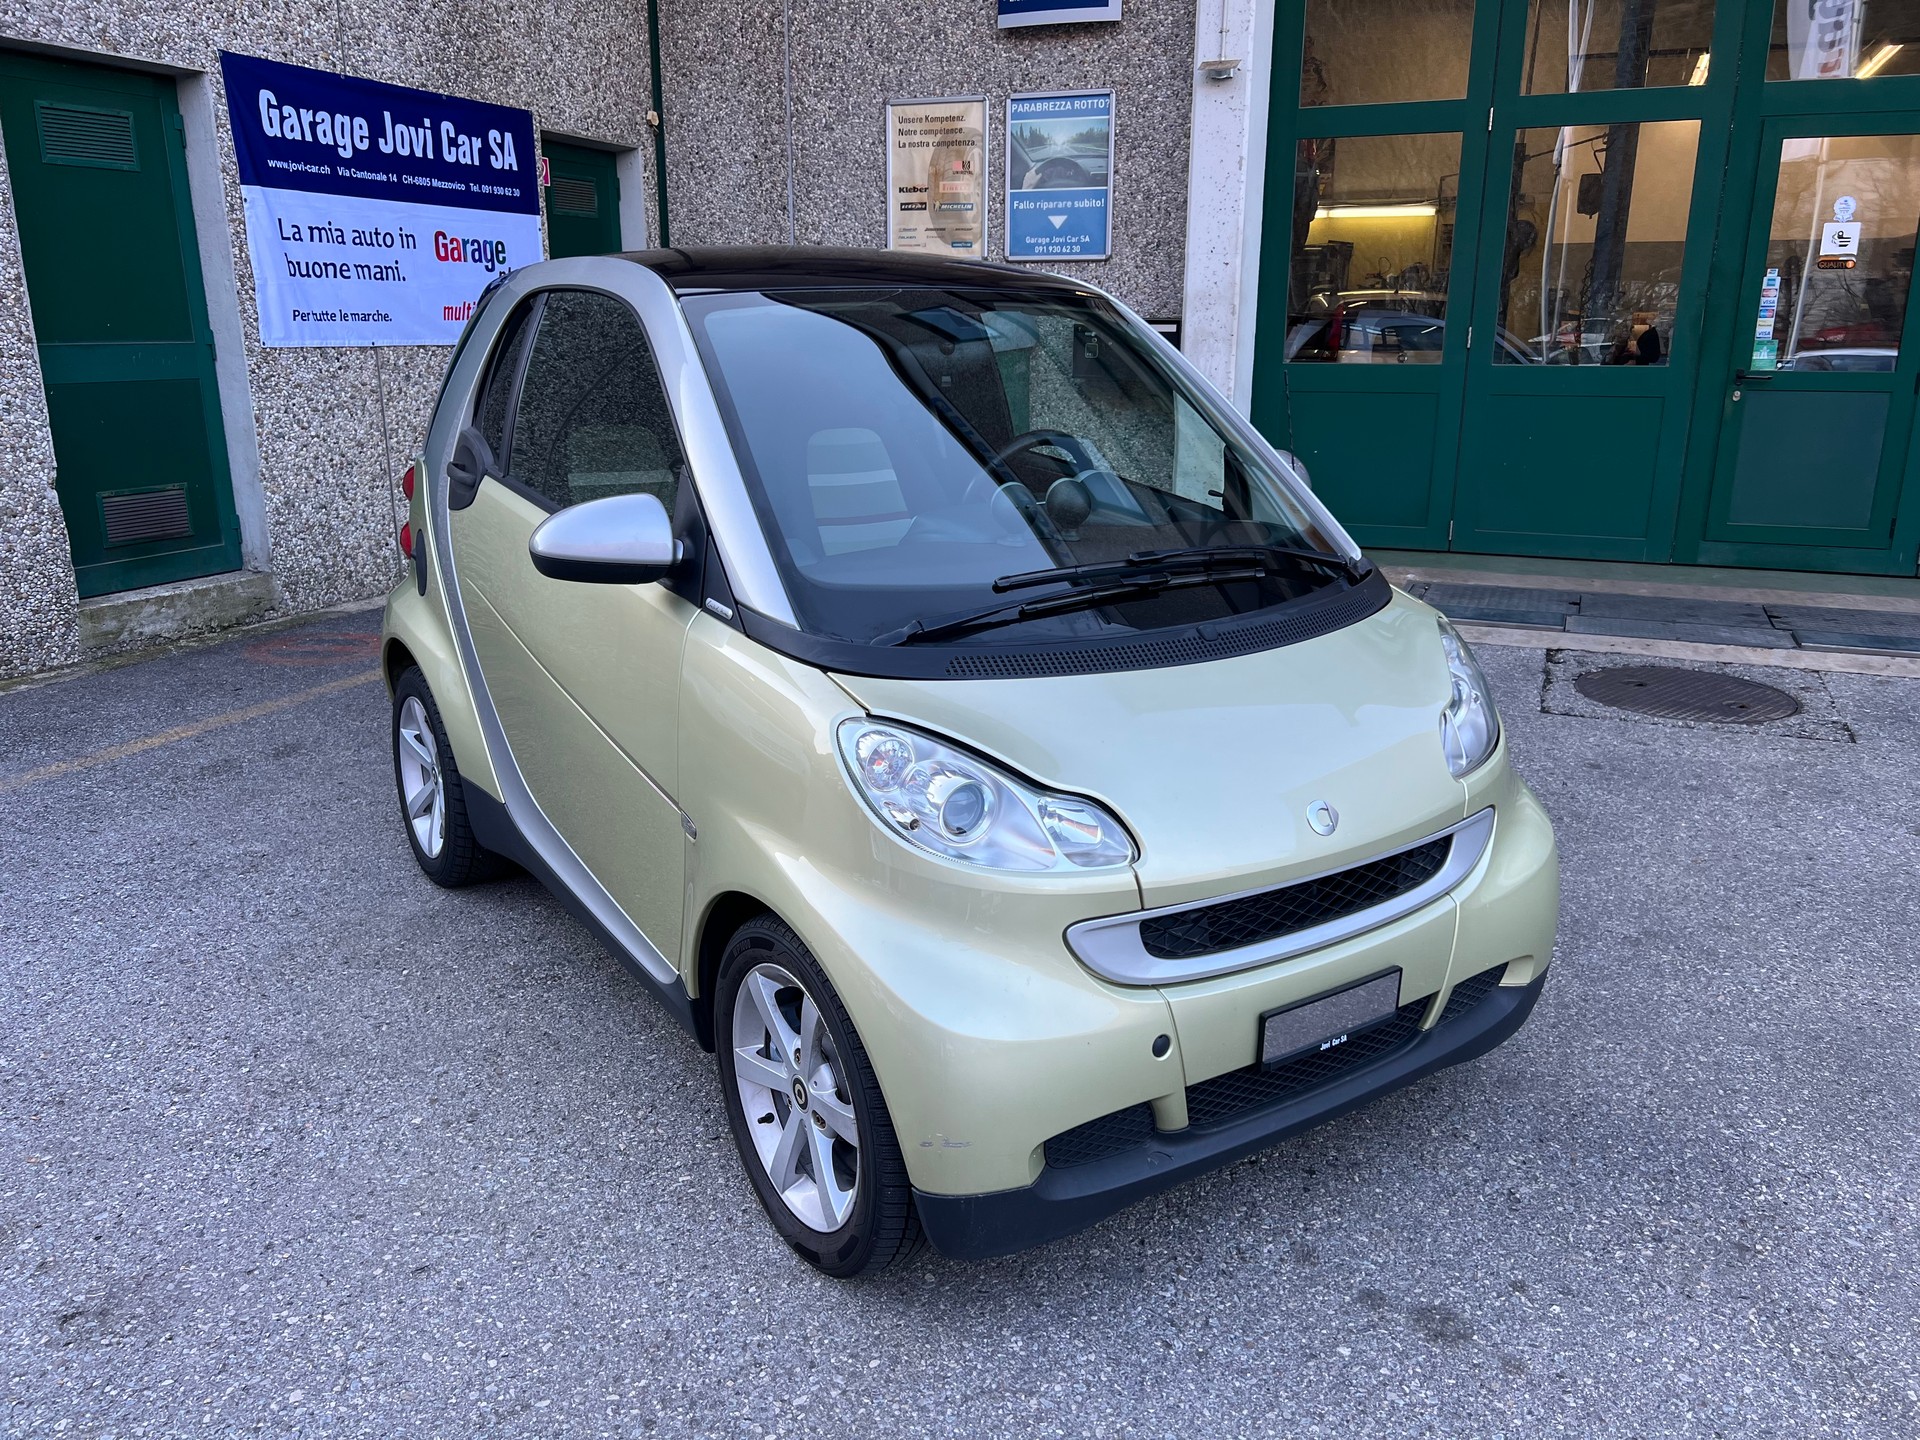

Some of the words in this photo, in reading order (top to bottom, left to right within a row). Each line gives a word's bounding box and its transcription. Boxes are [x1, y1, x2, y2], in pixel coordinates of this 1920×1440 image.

[1011, 101, 1072, 113] PARABREZZA
[1074, 98, 1110, 110] ROTTO?
[898, 115, 923, 125] Unsere
[924, 114, 966, 125] Kompetenz.
[258, 88, 370, 159] Garage
[378, 110, 434, 160] Jovi
[441, 120, 482, 167] Car
[489, 129, 519, 172] SA
[898, 128, 918, 137] Notre
[898, 140, 907, 149] La
[908, 140, 930, 149] nostra
[931, 138, 978, 149] competenza.
[267, 159, 331, 175] www.jovi-car.ch
[336, 166, 351, 178] Via
[351, 167, 388, 183] Cantonale
[388, 172, 398, 183] 14
[402, 174, 431, 187] CH-6805
[431, 177, 466, 192] Mezzovico
[469, 182, 480, 193] Tel.
[481, 184, 493, 194] 091
[493, 185, 505, 196] 930
[505, 187, 512, 197] 62
[512, 188, 521, 198] 30
[898, 185, 930, 194] Kleber
[1013, 200, 1035, 210] Fallo
[1036, 200, 1073, 211] riparare
[1073, 197, 1105, 208] subito!
[277, 216, 304, 243] La
[308, 219, 347, 246] mia
[351, 226, 395, 250] auto
[399, 226, 417, 250] in
[1025, 235, 1050, 245] Garage
[1051, 235, 1065, 244] Jovi
[1066, 235, 1079, 243] Car
[1080, 234, 1091, 243] SA
[433, 229, 507, 273] Garage
[1034, 245, 1047, 254] 091
[1048, 245, 1061, 253] 930
[1061, 245, 1071, 253] 62
[1071, 245, 1081, 253] 30
[284, 252, 351, 281] buone
[355, 259, 407, 282] mani.
[292, 309, 311, 322] Per
[311, 309, 337, 322] tutte
[339, 308, 349, 322] le
[350, 308, 393, 322] marche.
